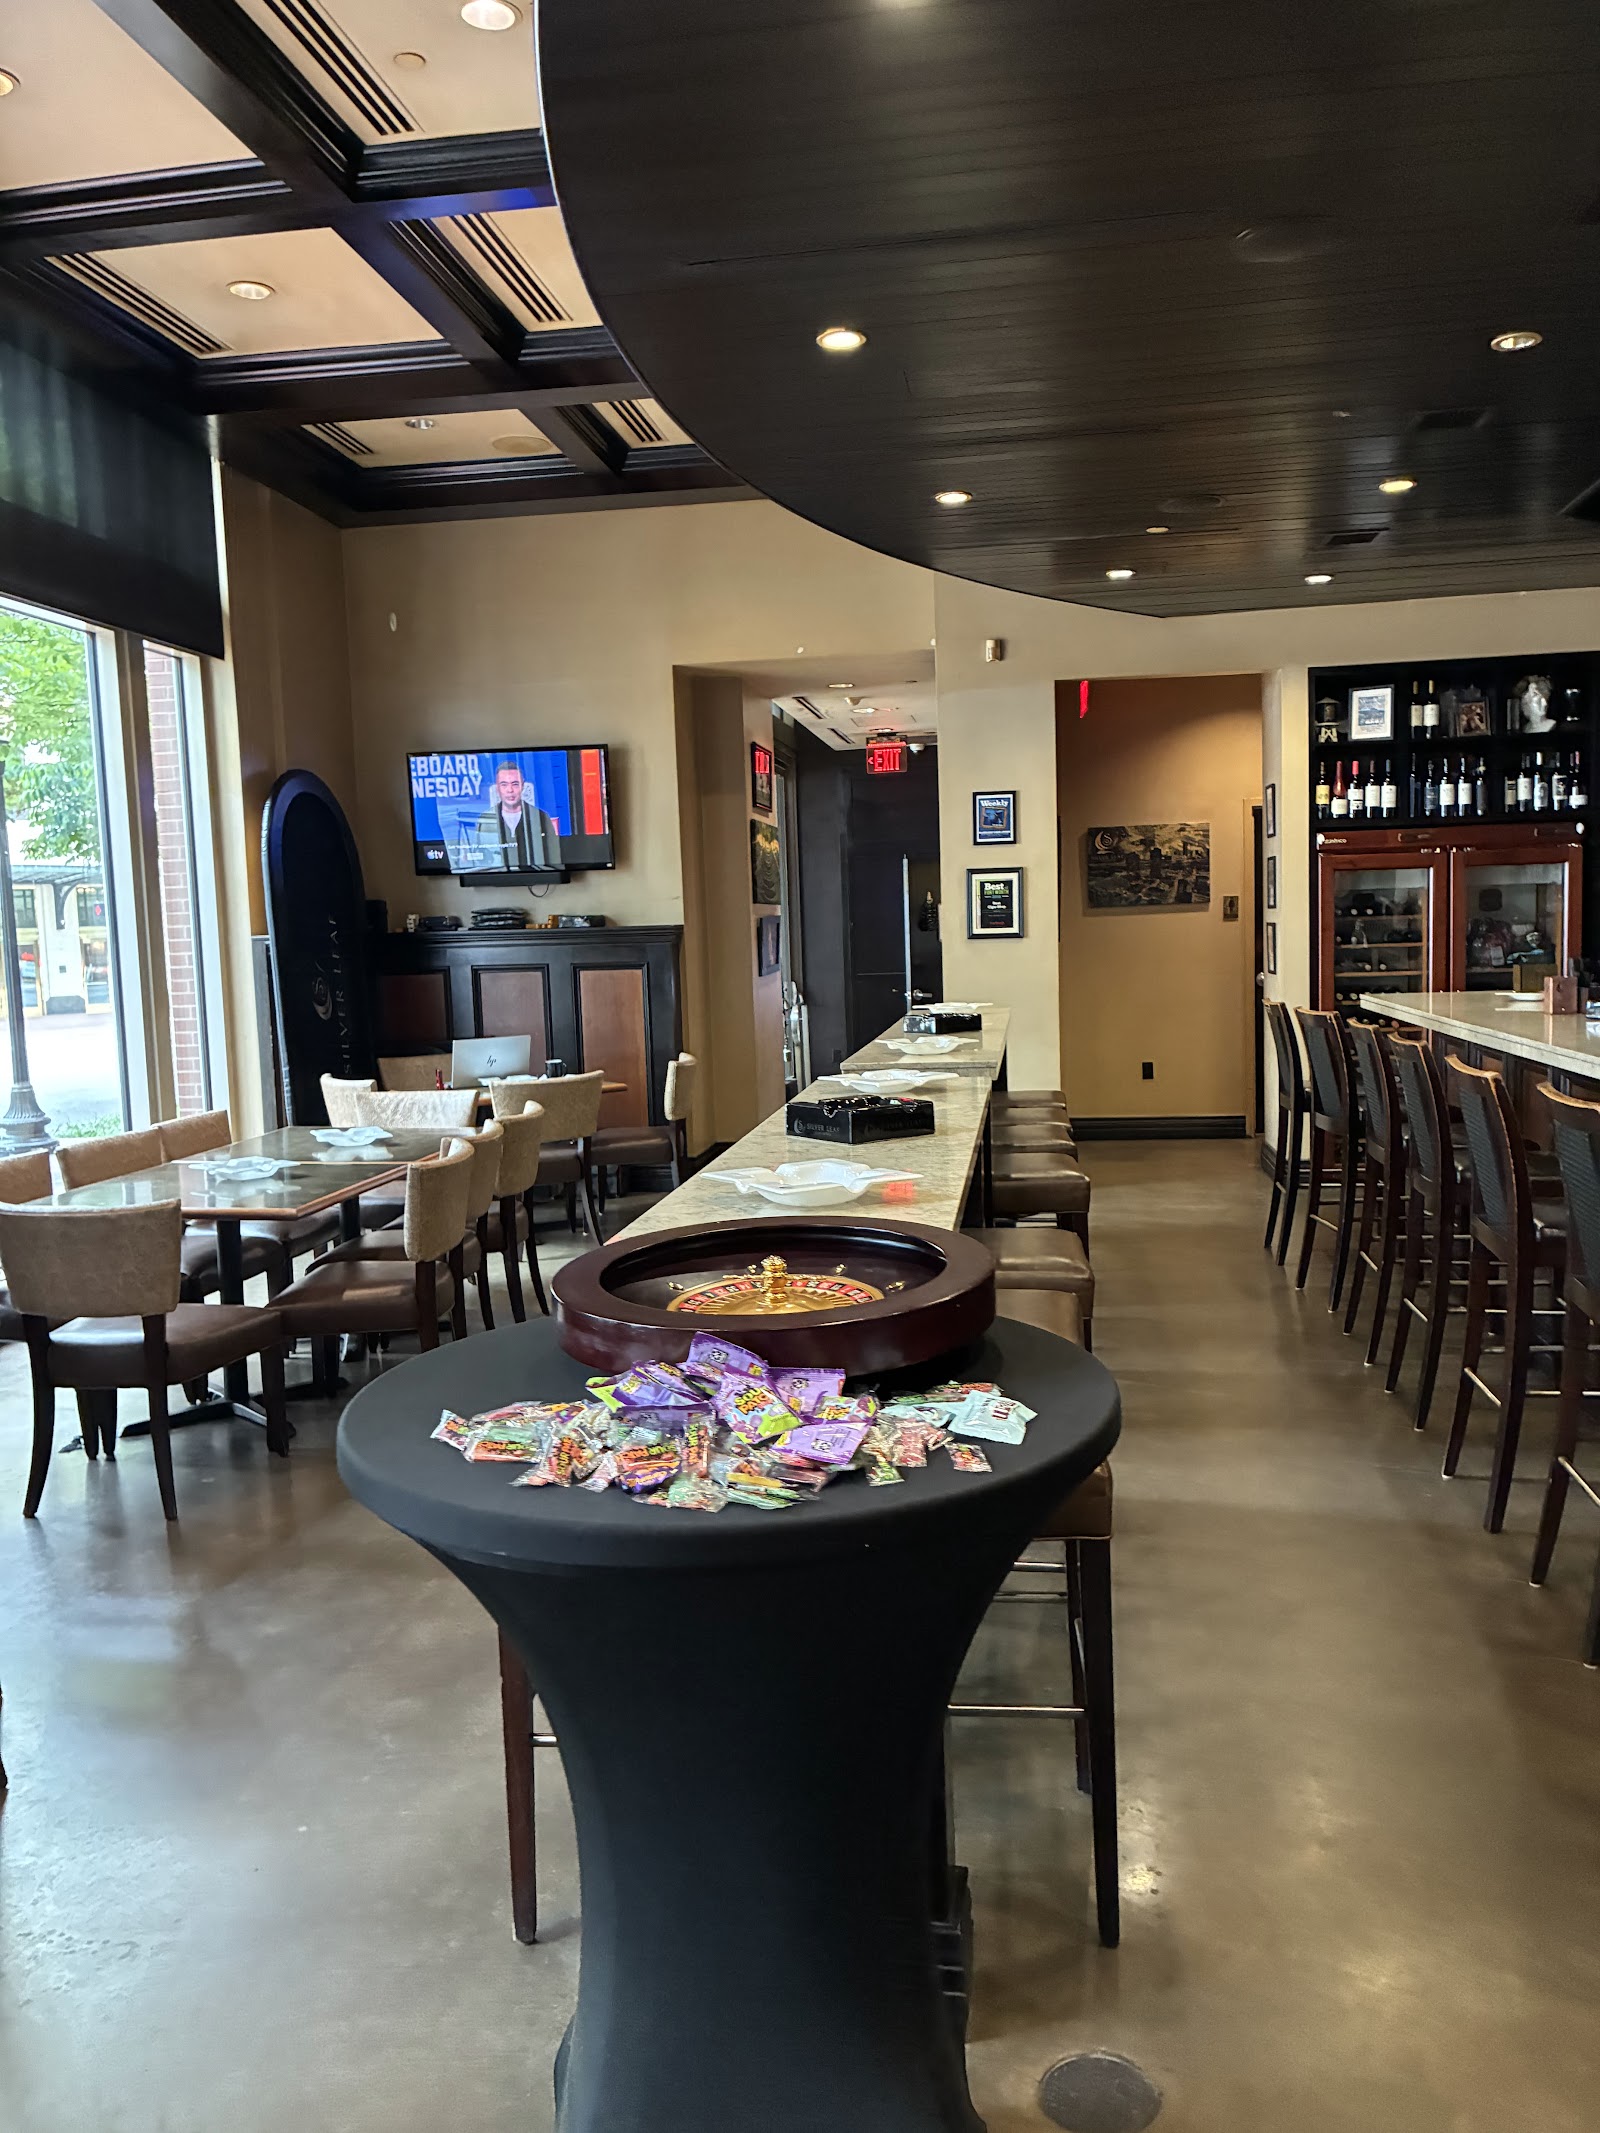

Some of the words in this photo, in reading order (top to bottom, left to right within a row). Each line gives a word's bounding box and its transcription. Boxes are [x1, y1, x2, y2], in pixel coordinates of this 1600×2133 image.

[873, 748, 902, 772] EXIT
[979, 799, 1009, 808] Weekly
[983, 882, 1005, 891] Best
[336, 990, 351, 1074] SILVER
[486, 1055, 498, 1068] hp
